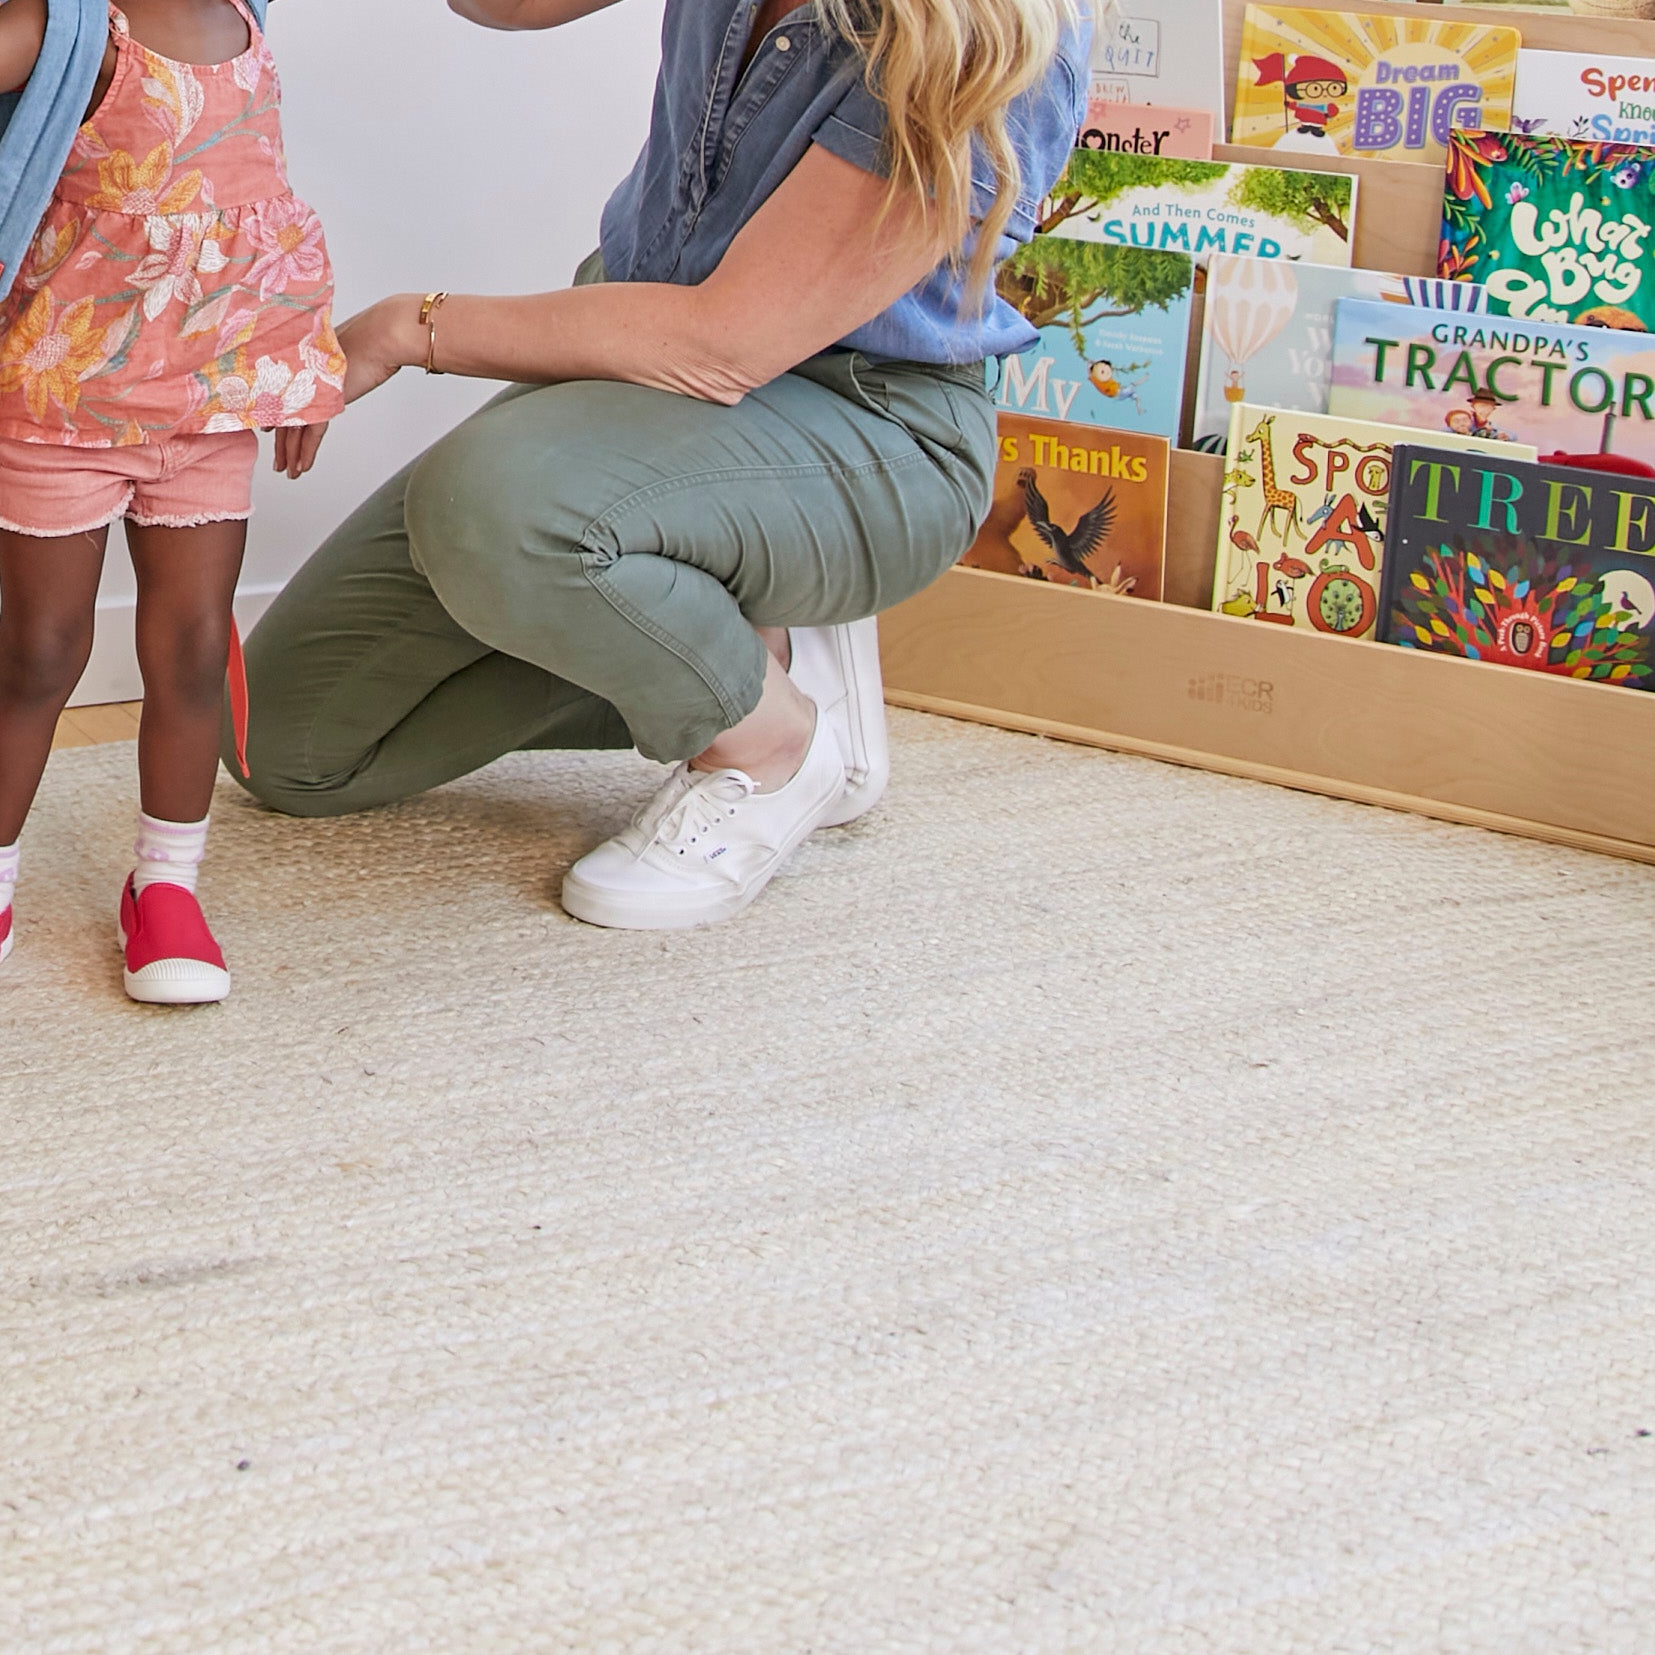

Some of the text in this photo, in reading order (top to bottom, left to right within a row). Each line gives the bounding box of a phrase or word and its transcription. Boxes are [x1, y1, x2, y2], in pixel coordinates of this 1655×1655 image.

[1375, 61, 1460, 84] Dream
[1352, 83, 1483, 151] BIG
[1103, 219, 1281, 259] SUMMER
[1132, 203, 1255, 228] And Then Comes
[1541, 247, 1643, 305] Bug
[1432, 323, 1589, 362] GRANDPA'S
[996, 353, 1083, 420] My
[1364, 336, 1655, 421] TRACTOR
[1028, 433, 1148, 483] Thanks
[1305, 493, 1375, 570] A
[1409, 459, 1655, 557] TREE
